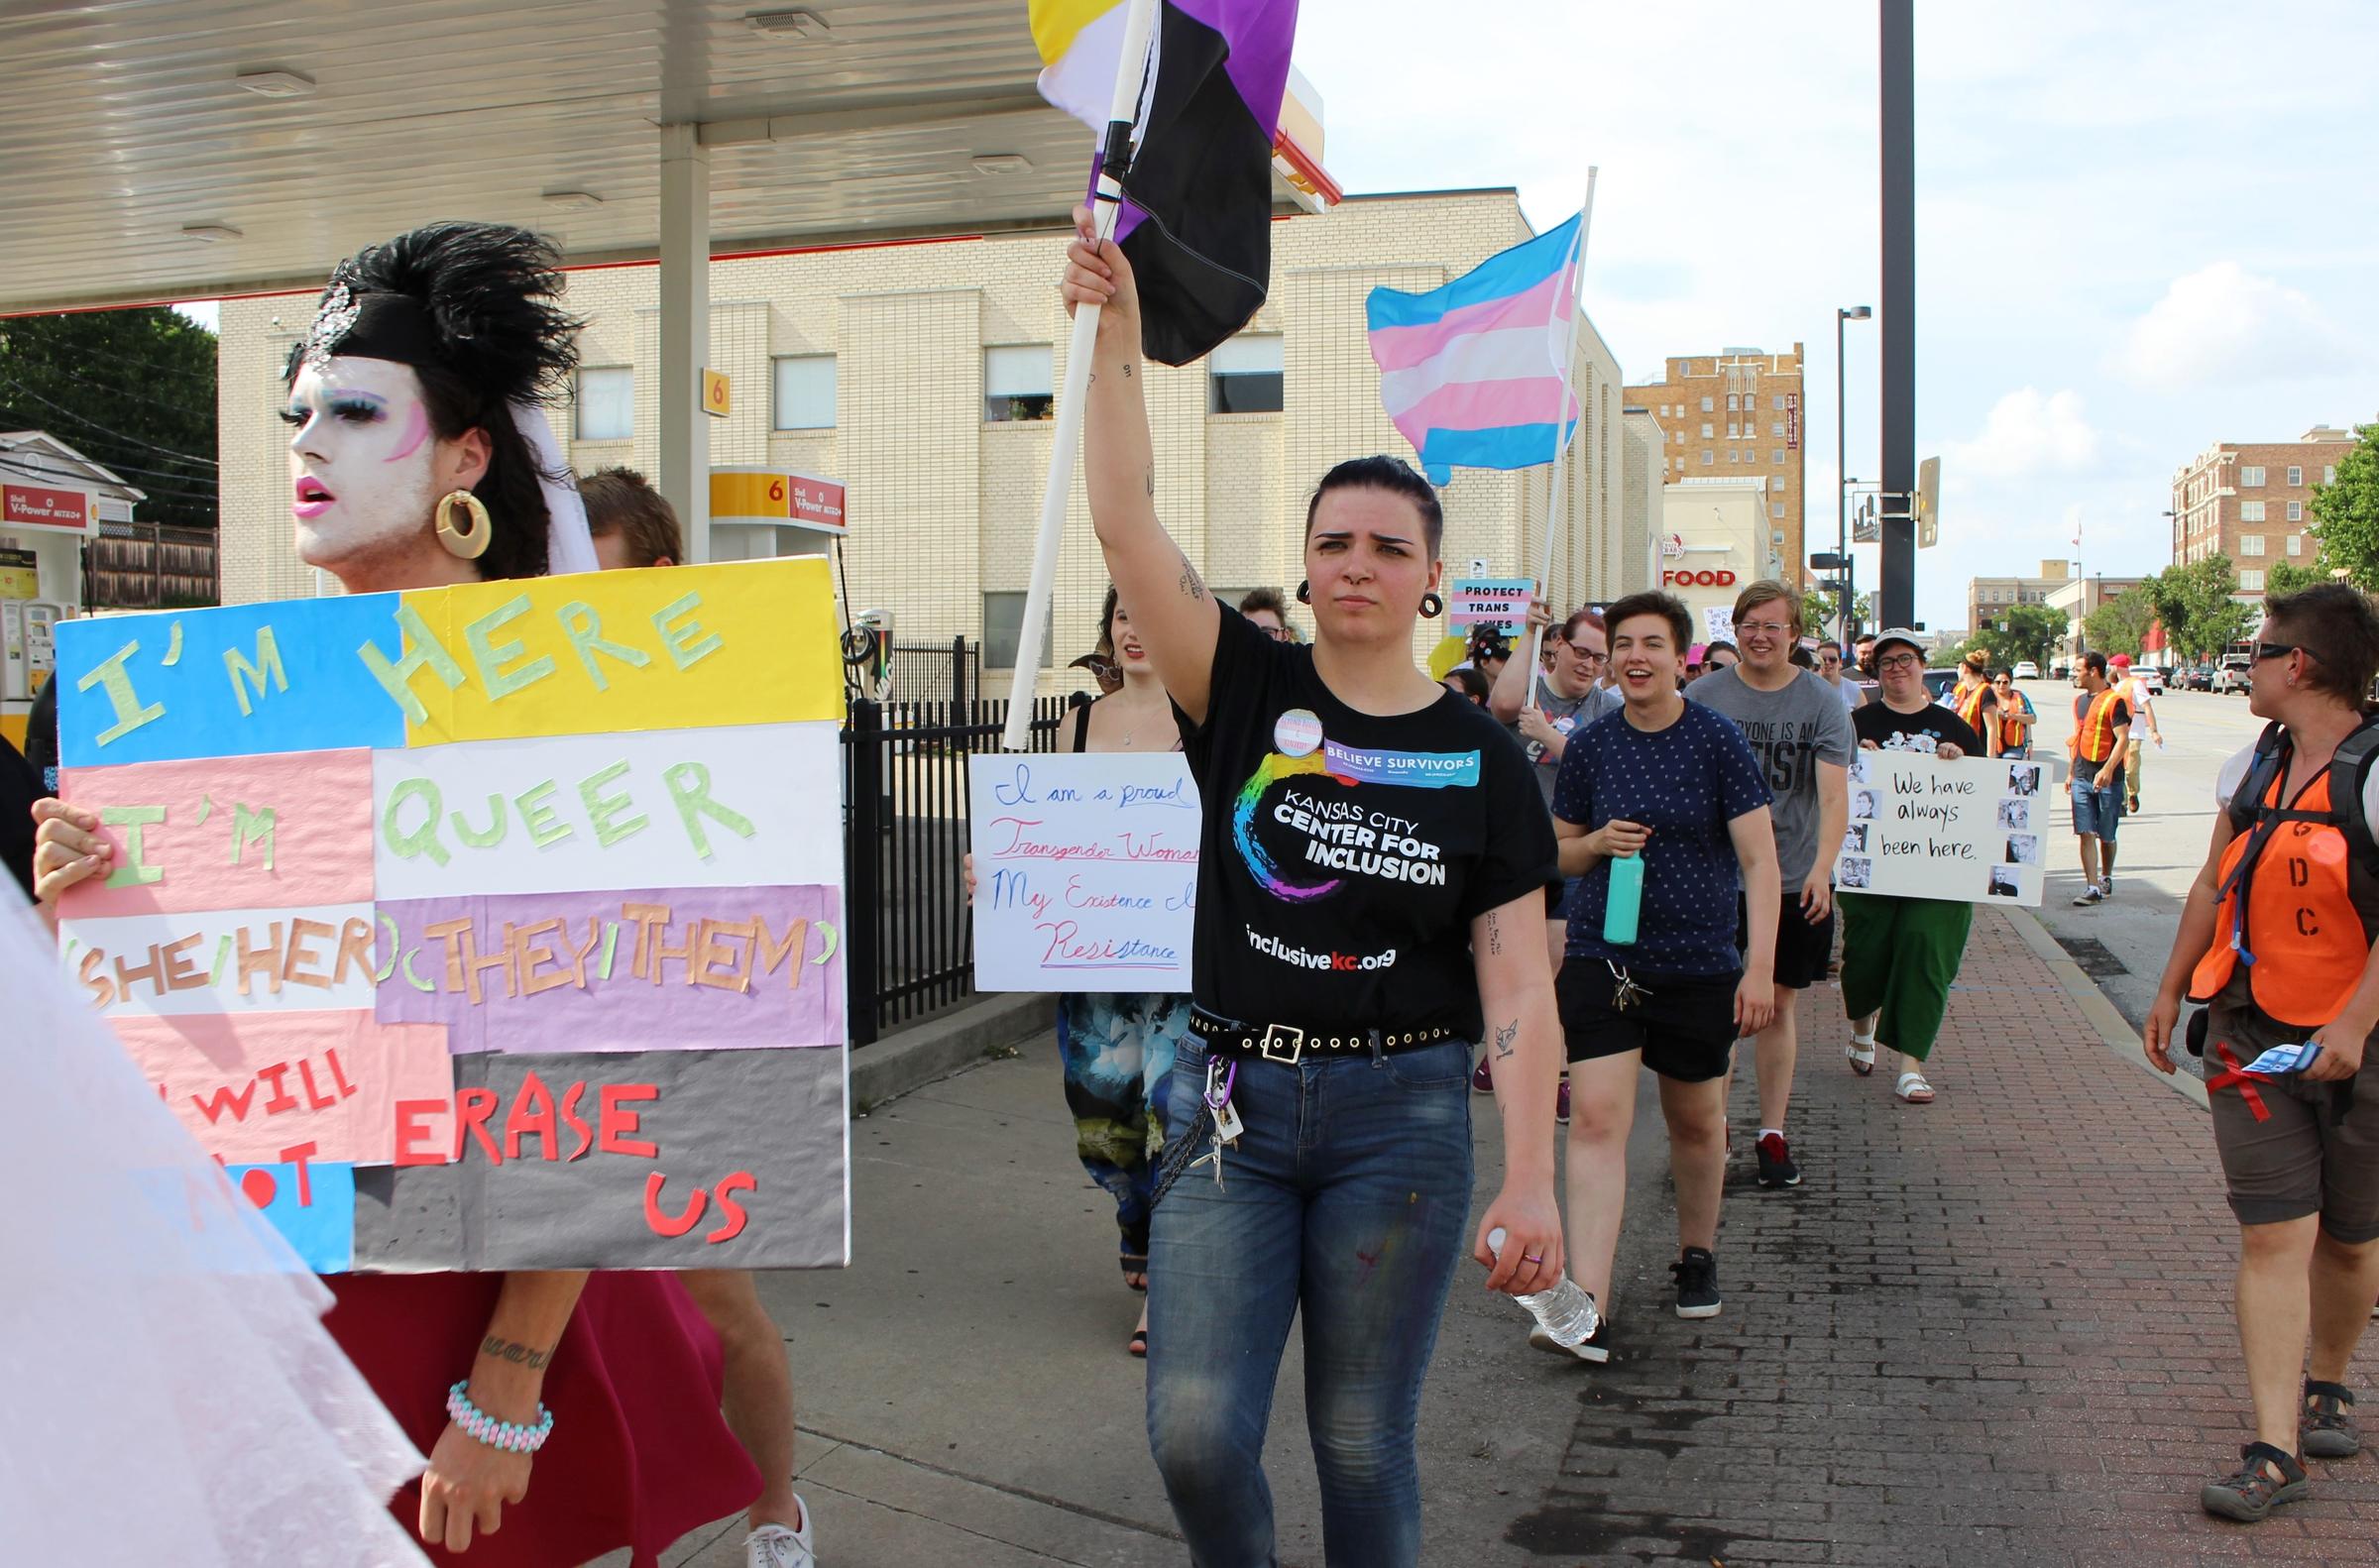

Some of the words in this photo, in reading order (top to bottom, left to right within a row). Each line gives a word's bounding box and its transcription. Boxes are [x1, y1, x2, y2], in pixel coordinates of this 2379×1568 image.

[713, 379, 724, 405] 6
[11, 503, 52, 516] V-Power
[768, 480, 784, 502] 6
[1465, 586, 1524, 598] PROTECT
[1662, 570, 1737, 587] FOOD
[1468, 603, 1510, 613] TRANS
[76, 619, 289, 747] I'M
[358, 591, 725, 728] HERE
[1781, 722, 1794, 740] IS
[1327, 745, 1382, 768] BELIEVE
[1387, 756, 1475, 771] SURVIVORS
[995, 763, 1037, 805] I
[1047, 786, 1082, 802] am
[1092, 789, 1113, 801] a
[1117, 777, 1186, 810] proud
[1893, 771, 1923, 794] We
[1931, 774, 1976, 796] have
[102, 793, 277, 889] I'M
[382, 757, 757, 867] QUEER
[1274, 804, 1377, 849] CENTER
[1381, 833, 1440, 860] FOR
[1285, 789, 1364, 822] KANSAS
[1369, 810, 1418, 836] CITY
[1897, 800, 1959, 834] always
[989, 817, 1115, 861] Transgender
[1880, 835, 1921, 856] been
[1929, 838, 1977, 860] here.
[1305, 840, 1446, 885] INCLUSION
[991, 867, 1053, 919] My
[1066, 873, 1152, 909] Existence
[1035, 920, 1179, 963] Resistance
[1246, 923, 1397, 971] inclusivekc.org
[192, 1048, 358, 1124] WILL
[393, 1070, 659, 1168] ERASE
[205, 1141, 317, 1213] OT
[643, 1171, 757, 1244] US
